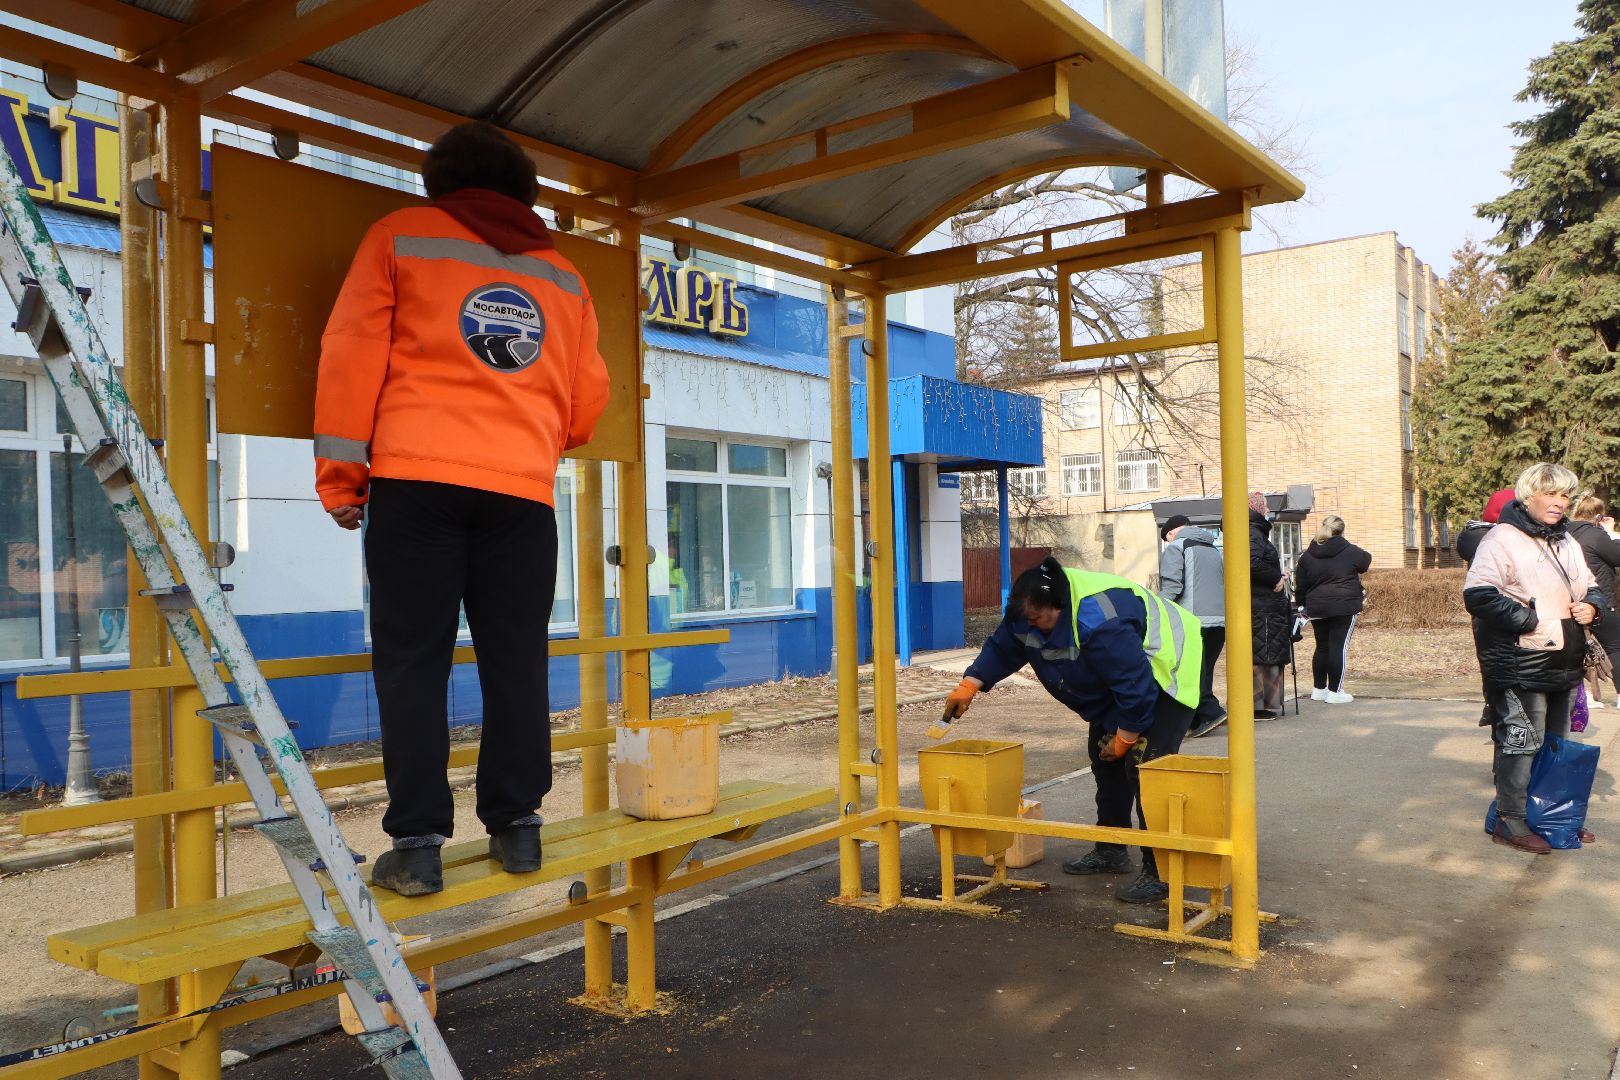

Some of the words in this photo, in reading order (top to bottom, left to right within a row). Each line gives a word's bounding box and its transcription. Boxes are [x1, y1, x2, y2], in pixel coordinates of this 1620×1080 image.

[473, 301, 536, 320] МОСАВТОДОР
[644, 256, 748, 335] АРЬ
[30, 1028, 130, 1060] ALUMET
